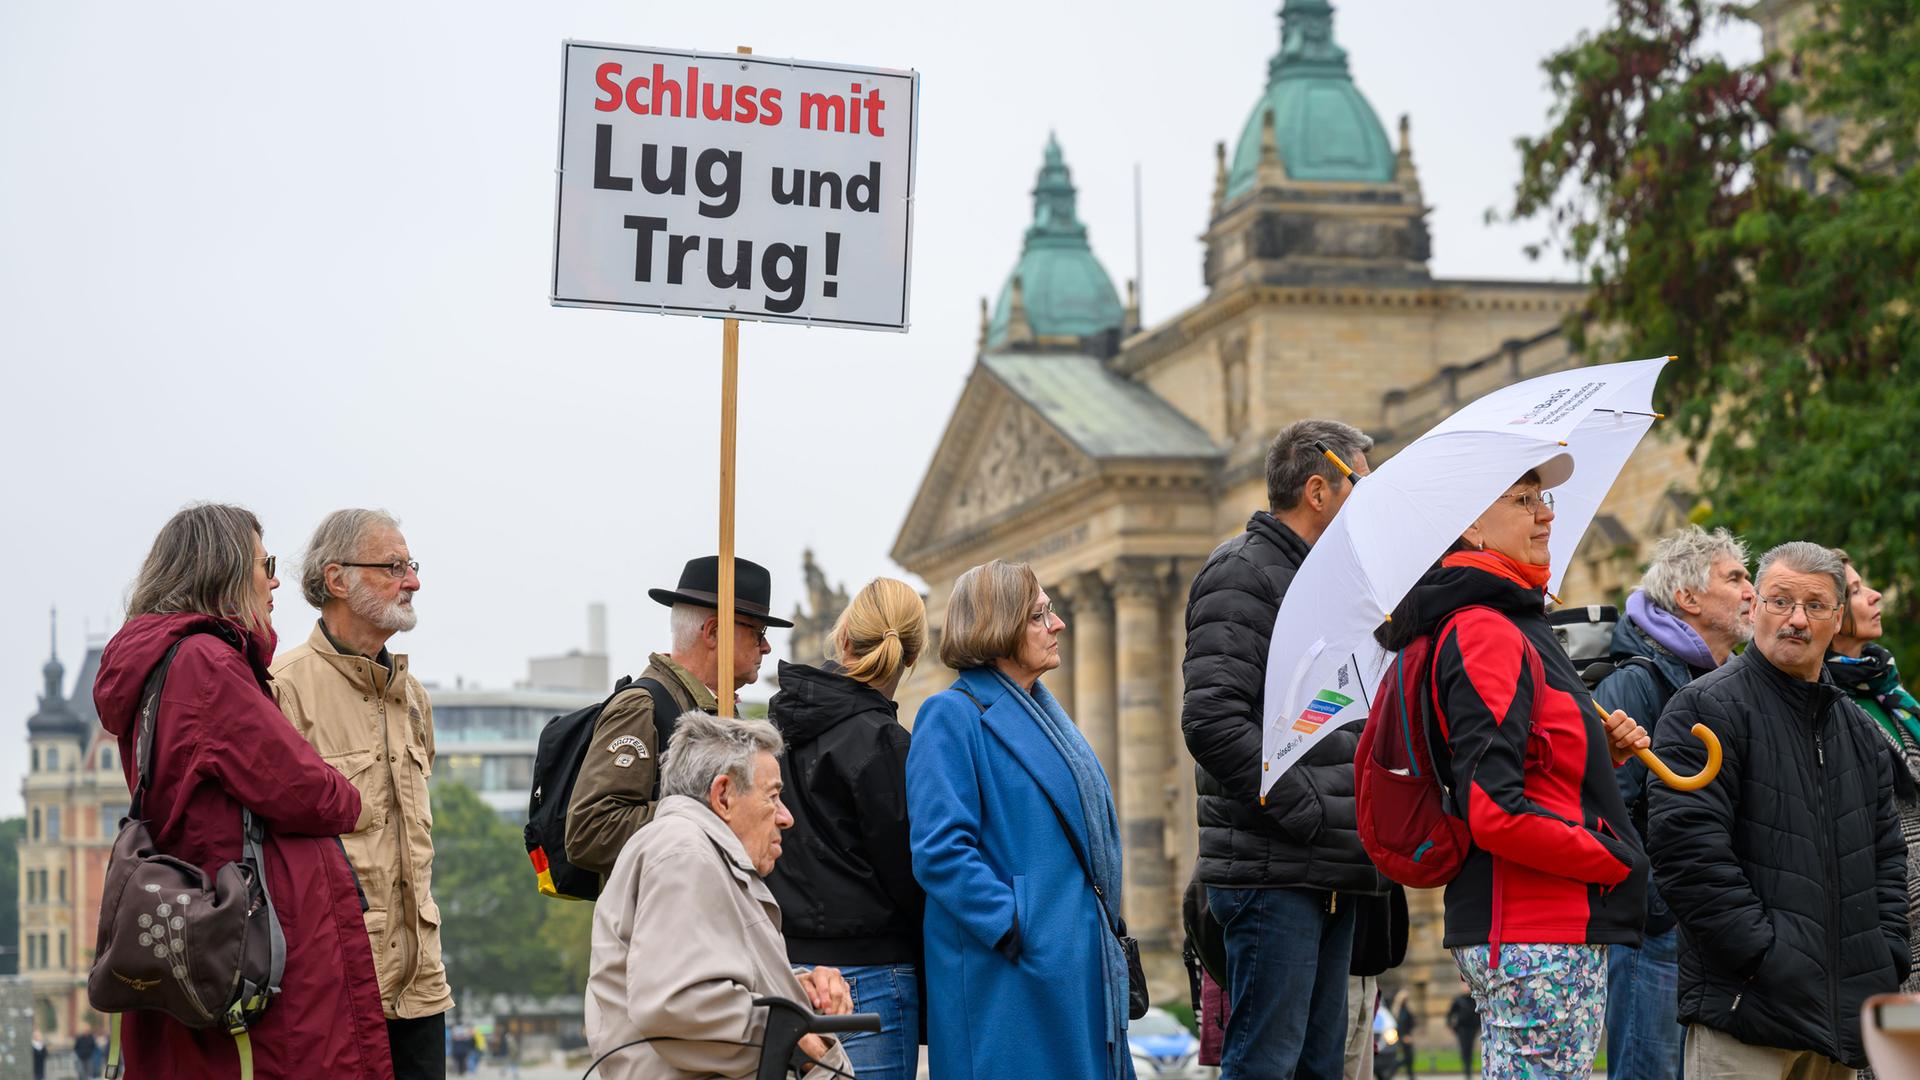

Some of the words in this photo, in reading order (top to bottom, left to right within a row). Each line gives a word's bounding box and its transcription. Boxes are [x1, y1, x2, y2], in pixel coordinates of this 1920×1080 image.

[594, 62, 783, 126] Schluss
[800, 83, 885, 137] mit
[593, 123, 743, 219] Lug
[771, 161, 881, 213] und
[624, 215, 841, 313] Trug!
